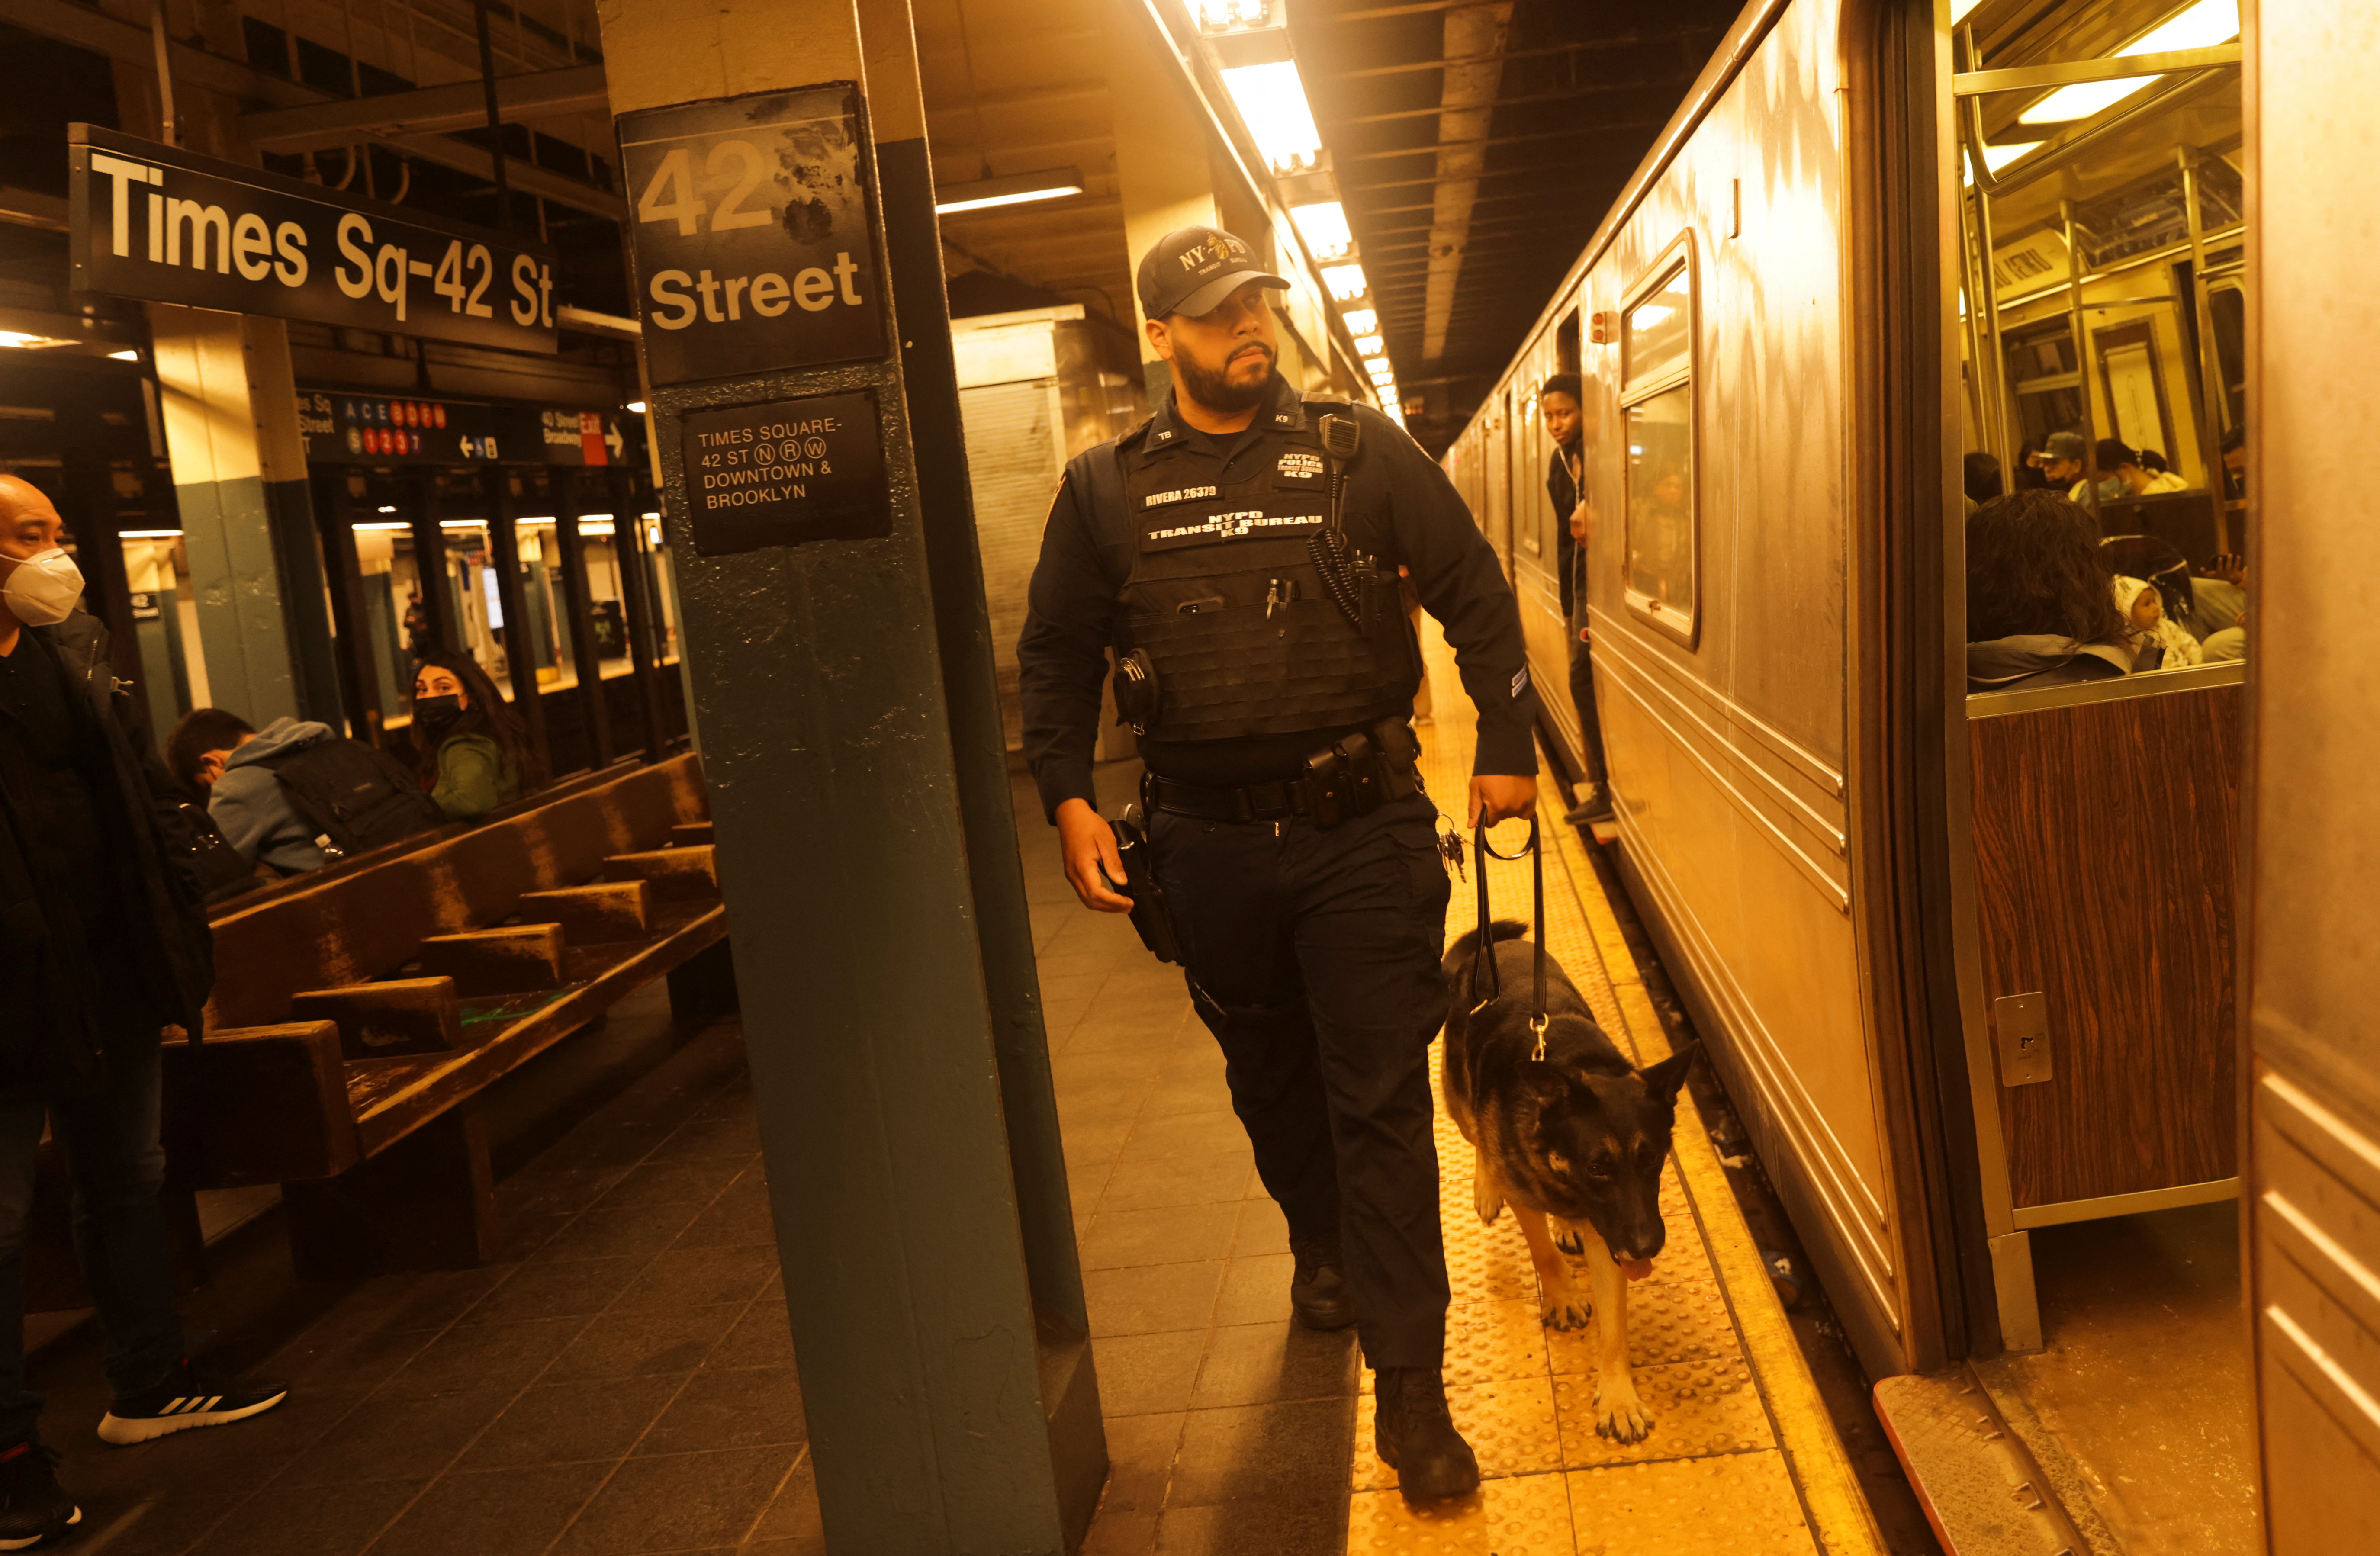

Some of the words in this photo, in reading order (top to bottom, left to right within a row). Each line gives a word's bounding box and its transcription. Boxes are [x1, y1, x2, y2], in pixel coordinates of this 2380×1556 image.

[638, 139, 772, 237] 42
[91, 153, 309, 288] Times
[335, 212, 492, 321] Sq-42
[511, 254, 553, 328] St
[650, 252, 862, 331] Street
[347, 401, 356, 418] A
[361, 403, 372, 419] C
[376, 403, 387, 420] E
[1275, 415, 1288, 423] K9
[698, 428, 753, 447] TIMES
[759, 418, 843, 440] SQUARE-
[1158, 431, 1172, 440] TB
[701, 454, 721, 468] 42
[728, 449, 749, 466] ST
[1278, 459, 1323, 468] POLICE
[704, 462, 814, 489] DOWNTOWN
[821, 460, 832, 475] &
[707, 484, 806, 509] BROOKLYN
[1146, 490, 1182, 507] RIVERA
[1183, 486, 1216, 500] 26379
[1148, 521, 1235, 540] TRANSIT
[1239, 515, 1322, 527] BUREAU
[1209, 511, 1263, 524] NYPD
[1221, 527, 1249, 537] K9
